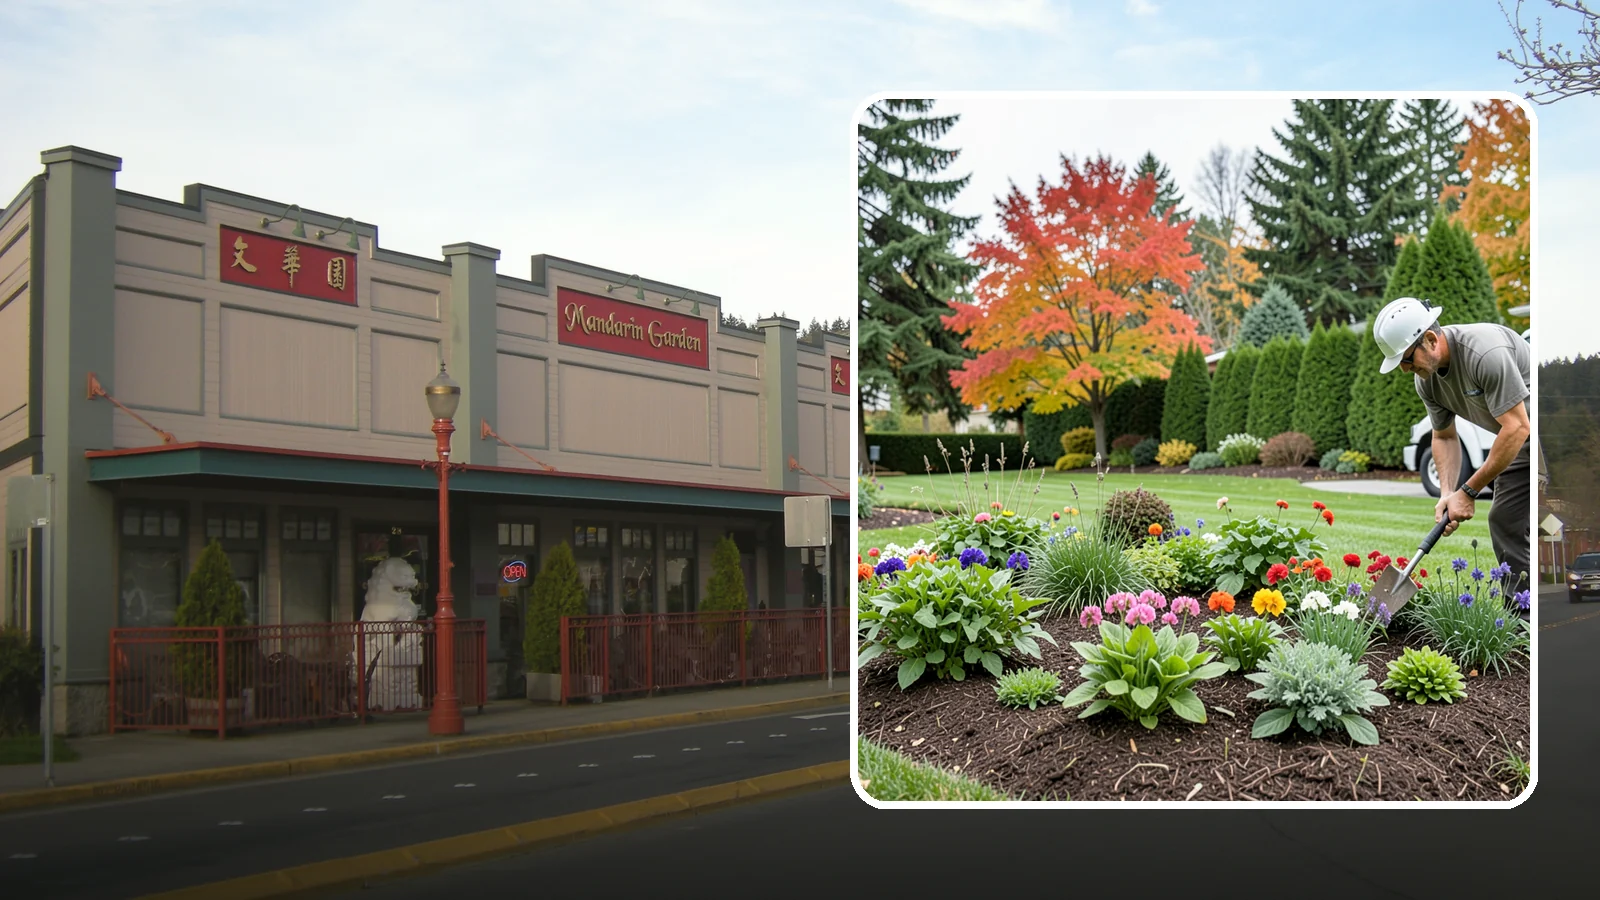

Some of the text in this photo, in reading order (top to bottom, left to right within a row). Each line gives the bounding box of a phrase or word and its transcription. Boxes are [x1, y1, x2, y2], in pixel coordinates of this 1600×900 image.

[565, 302, 701, 352] Mandarin Garden
[503, 565, 527, 578] OPEN
